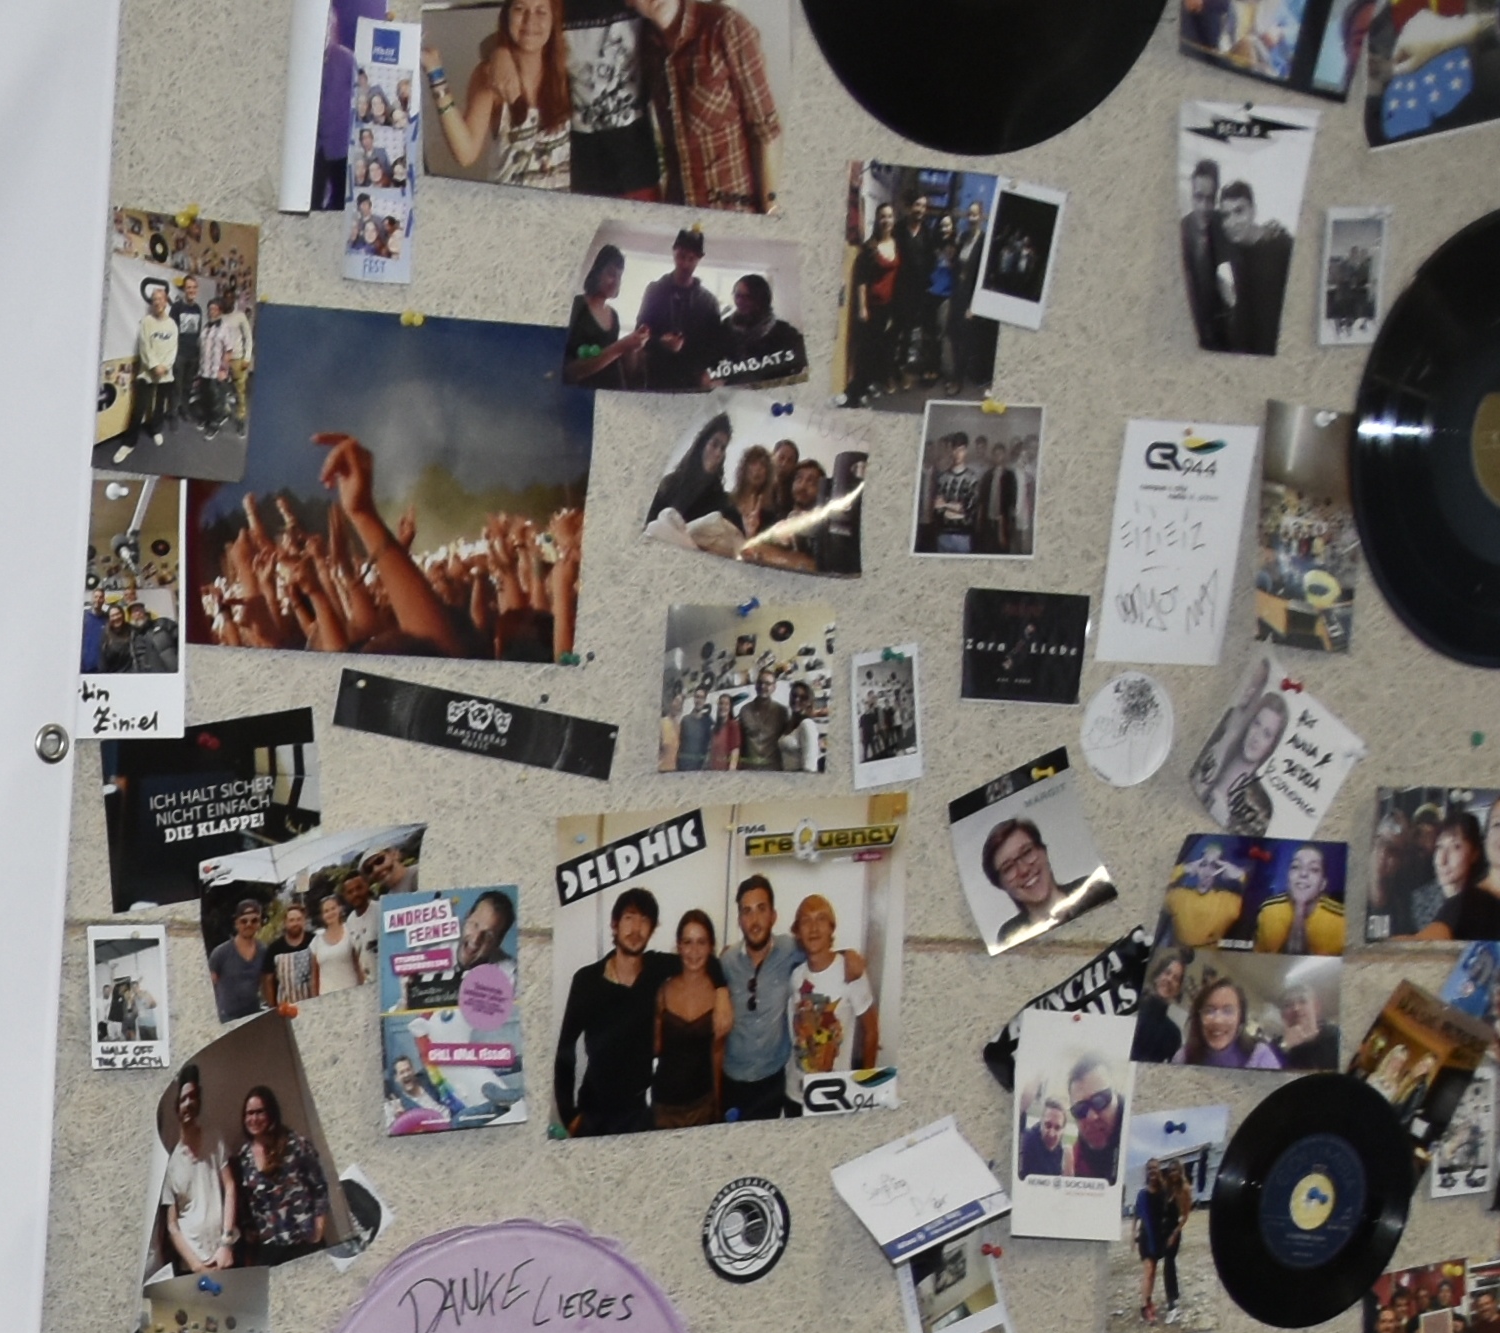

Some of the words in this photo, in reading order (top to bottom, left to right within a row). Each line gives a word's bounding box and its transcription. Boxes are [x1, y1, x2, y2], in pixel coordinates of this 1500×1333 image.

[707, 350, 795, 381] WOMBATS
[965, 637, 1006, 653] Zorn
[1030, 642, 1078, 656] Liebe
[148, 792, 179, 811] ICH
[181, 785, 218, 808] HALT
[220, 776, 275, 802] SICHER
[155, 804, 204, 827] NICHT
[206, 794, 271, 819] EINFACH
[163, 825, 196, 844] DIE
[197, 813, 265, 840] KLAPPE!
[560, 816, 700, 899] DELPHIC
[388, 903, 449, 930] ANDREAS
[408, 923, 460, 946] FERNER
[532, 1276, 634, 1327] LIEBES
